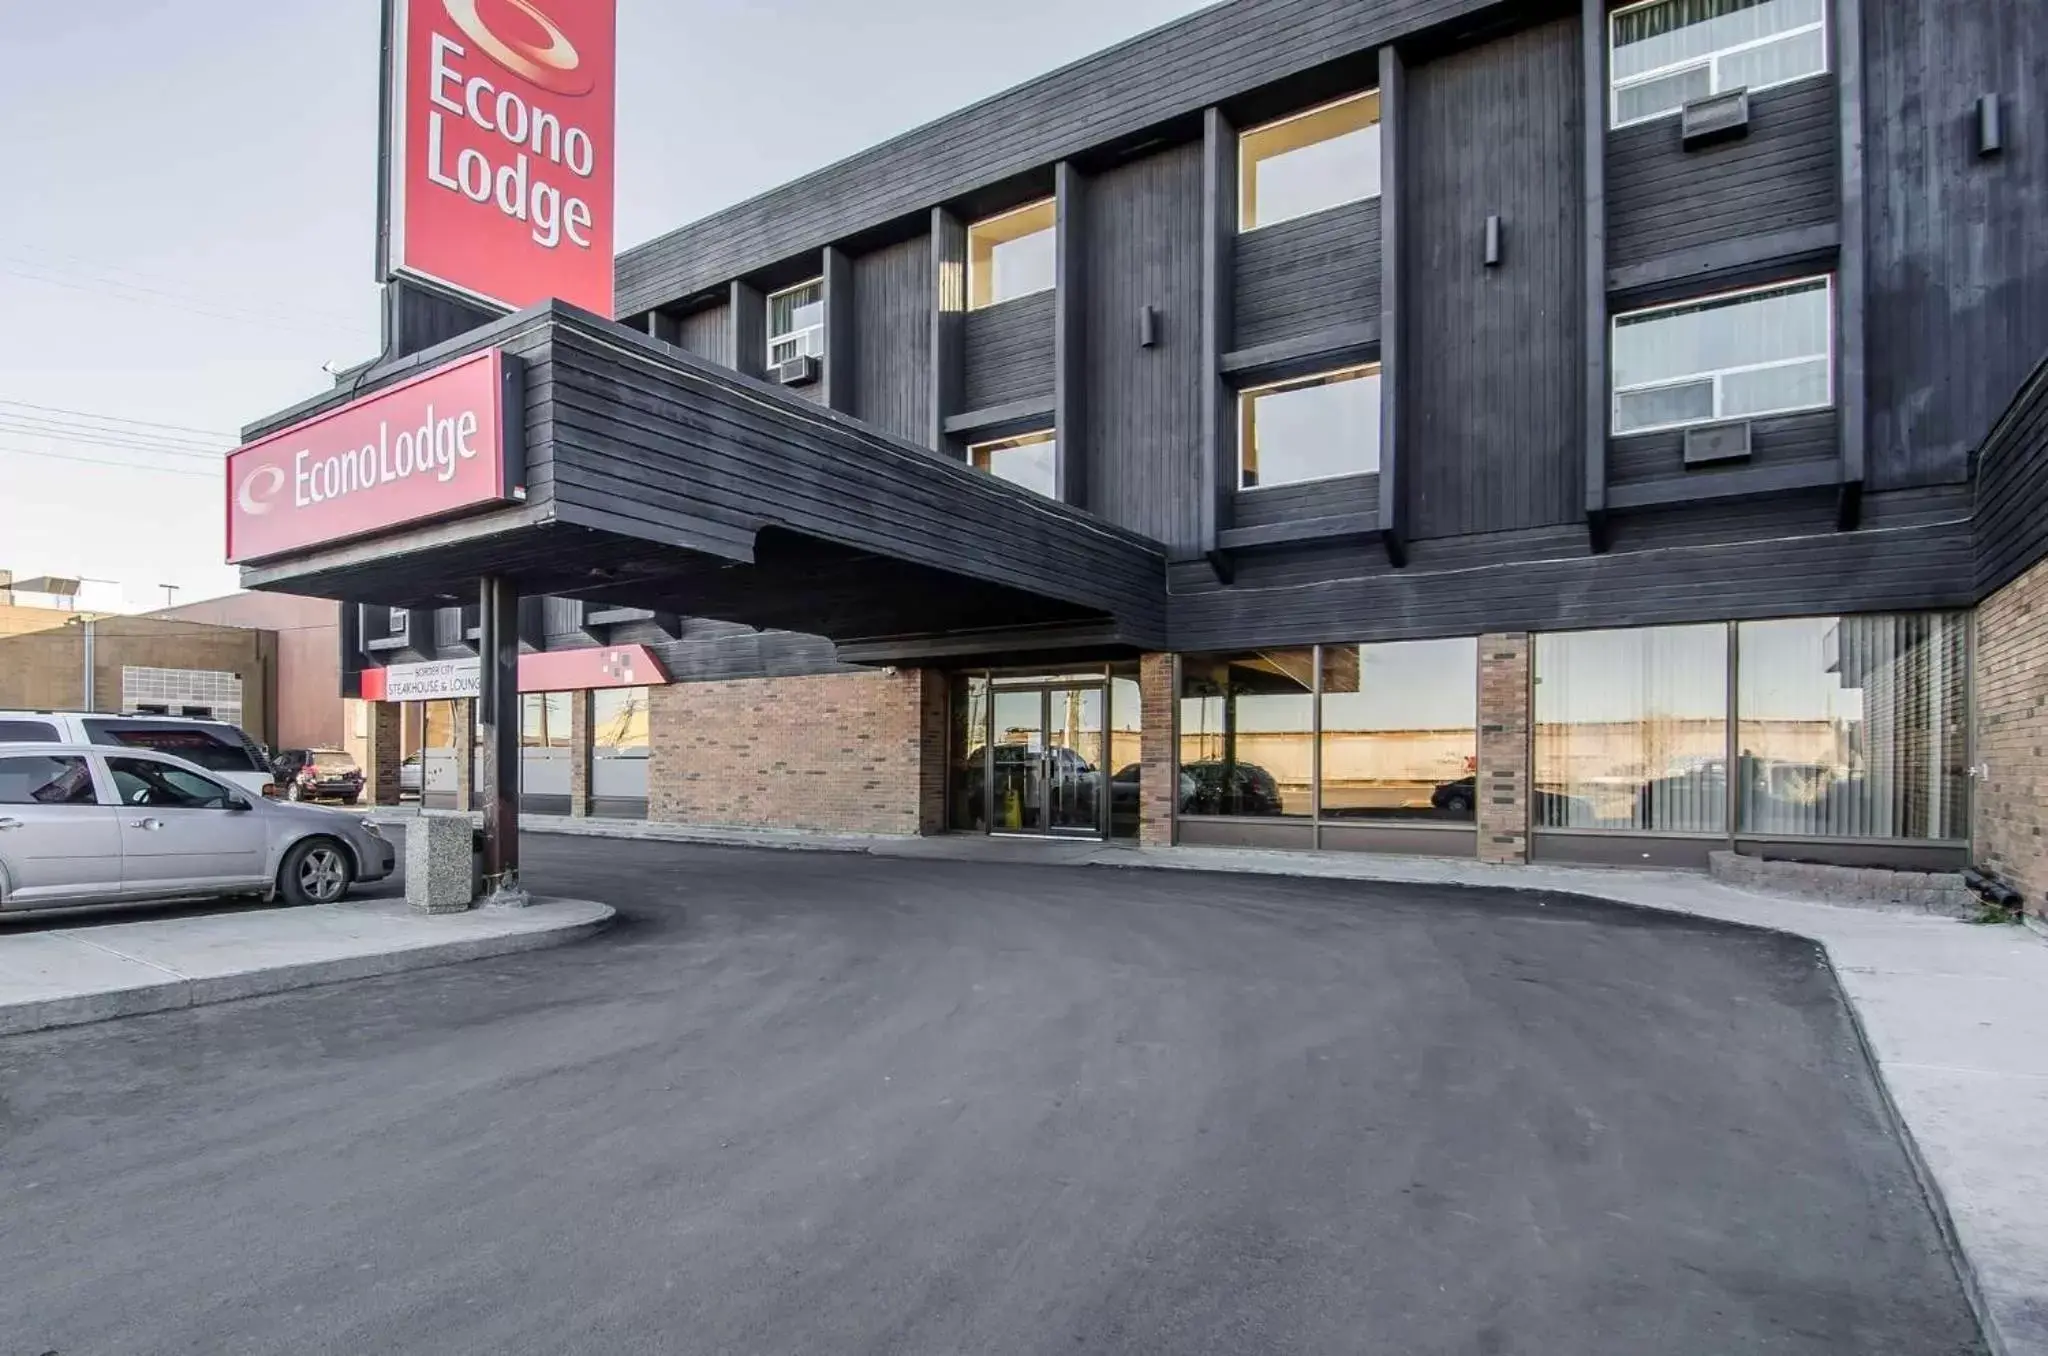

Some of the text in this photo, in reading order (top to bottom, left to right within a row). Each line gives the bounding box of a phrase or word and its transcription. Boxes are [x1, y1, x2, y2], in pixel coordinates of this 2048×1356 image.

[430, 31, 593, 177] Econo
[428, 110, 592, 248] Lodge
[295, 404, 477, 507] EconoLodge
[389, 677, 480, 695] STEAKHOUSE & LOUNG
[440, 664, 455, 675] CITY
